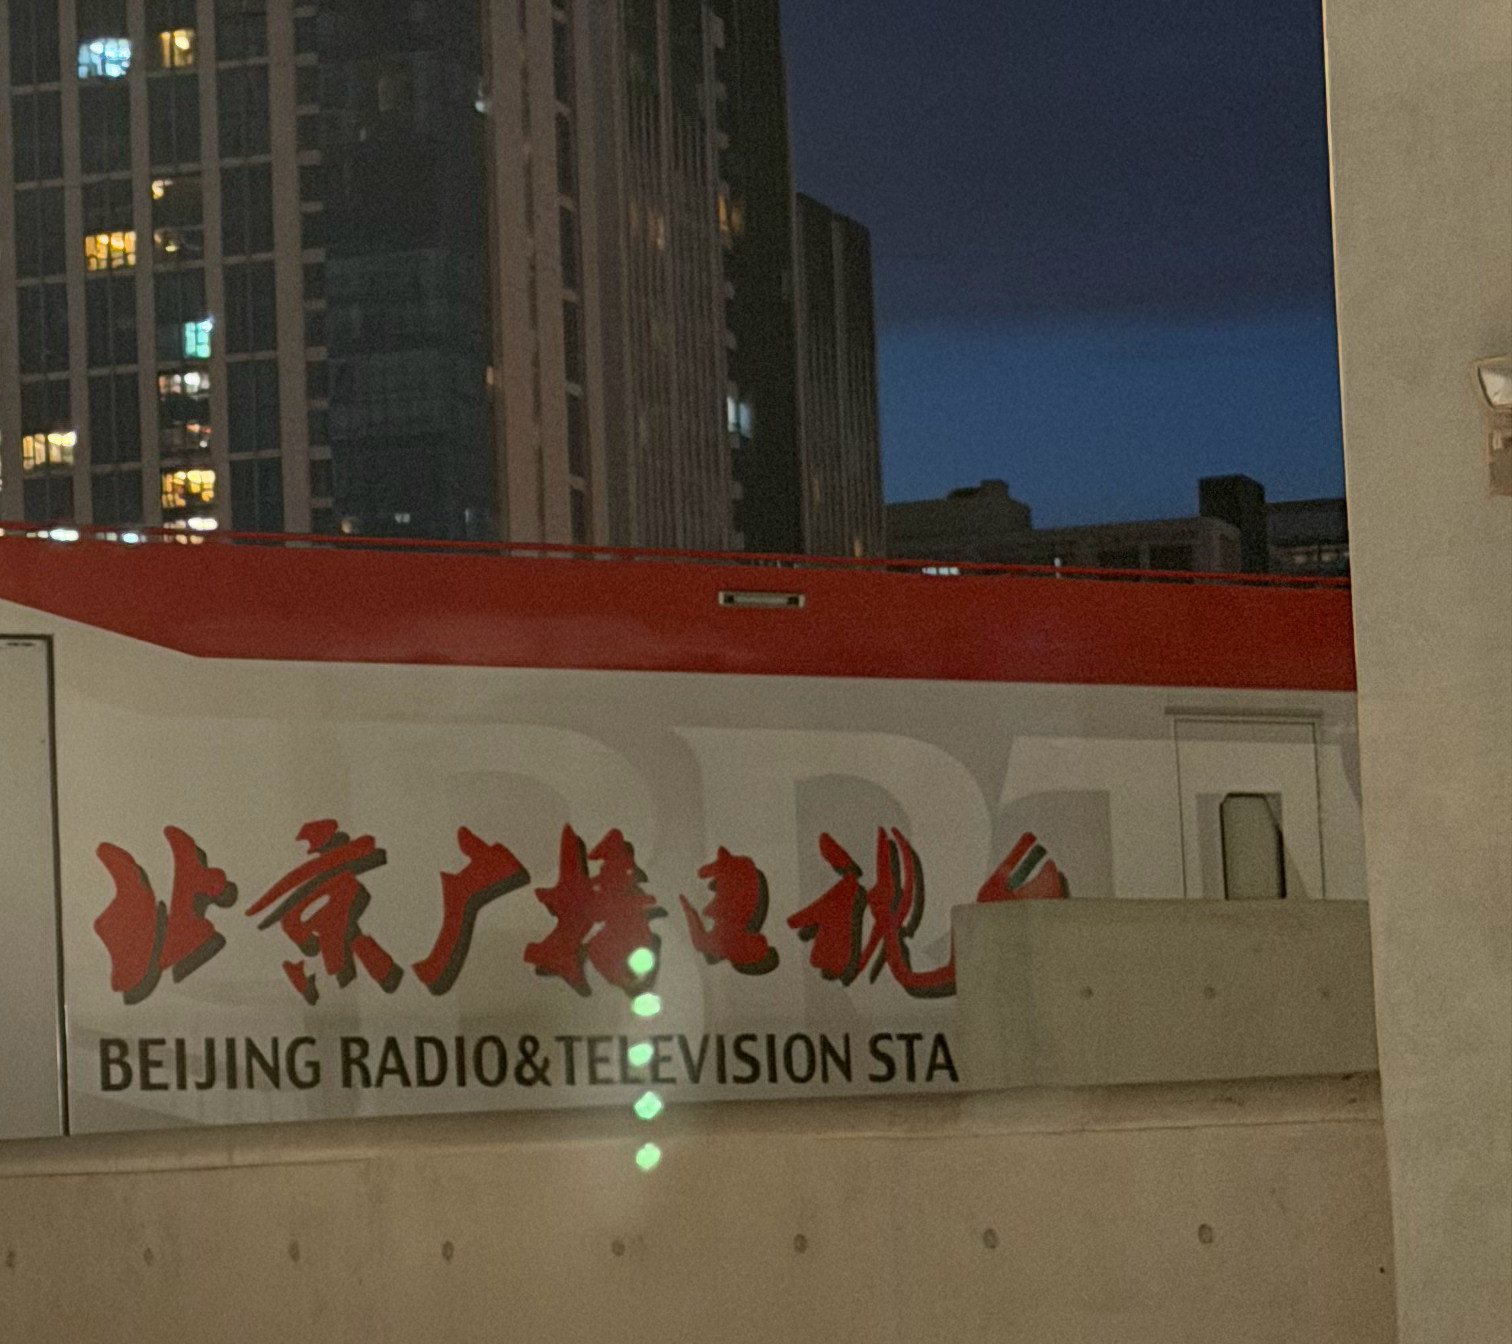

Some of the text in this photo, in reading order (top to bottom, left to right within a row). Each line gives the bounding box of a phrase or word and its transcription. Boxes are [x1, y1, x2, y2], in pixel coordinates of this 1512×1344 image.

[100, 1032, 959, 1092] BEIJING RADIO&TELEVISION STA
